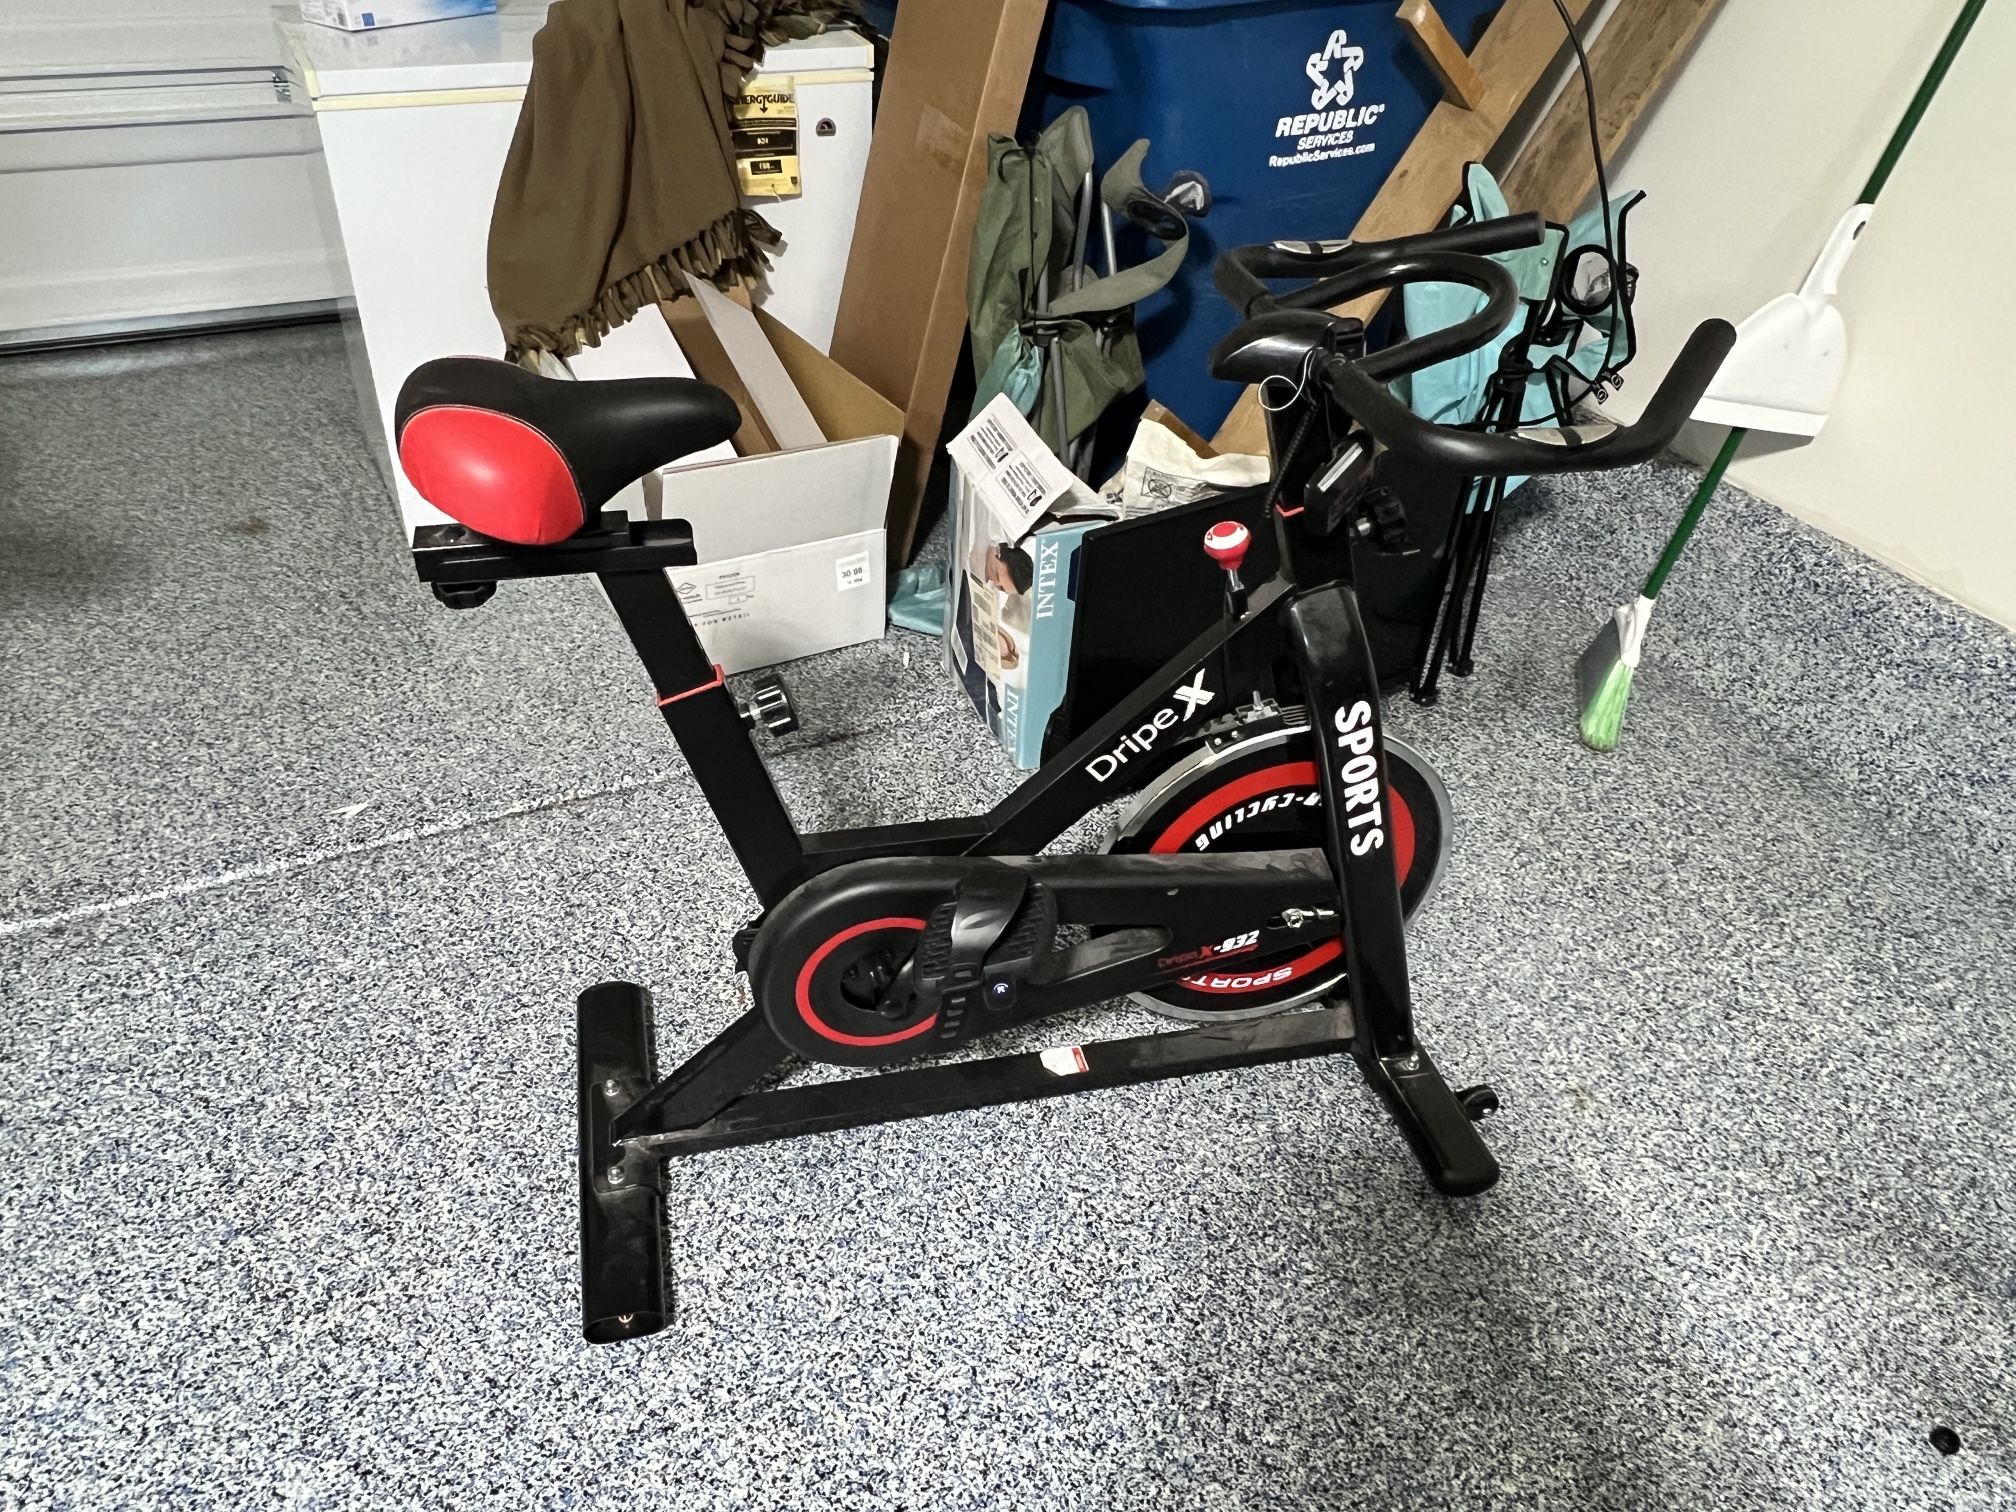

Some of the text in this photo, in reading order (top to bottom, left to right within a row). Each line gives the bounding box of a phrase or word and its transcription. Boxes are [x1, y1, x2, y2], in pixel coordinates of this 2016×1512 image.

[1275, 105, 1379, 137] REPUBLIC
[1297, 130, 1354, 150] SERVICES
[1269, 143, 1376, 167] RepublicServices.com
[1036, 541, 1059, 620] INTEX
[1085, 668, 1215, 783] DripeX
[1335, 700, 1384, 856] SPORTS
